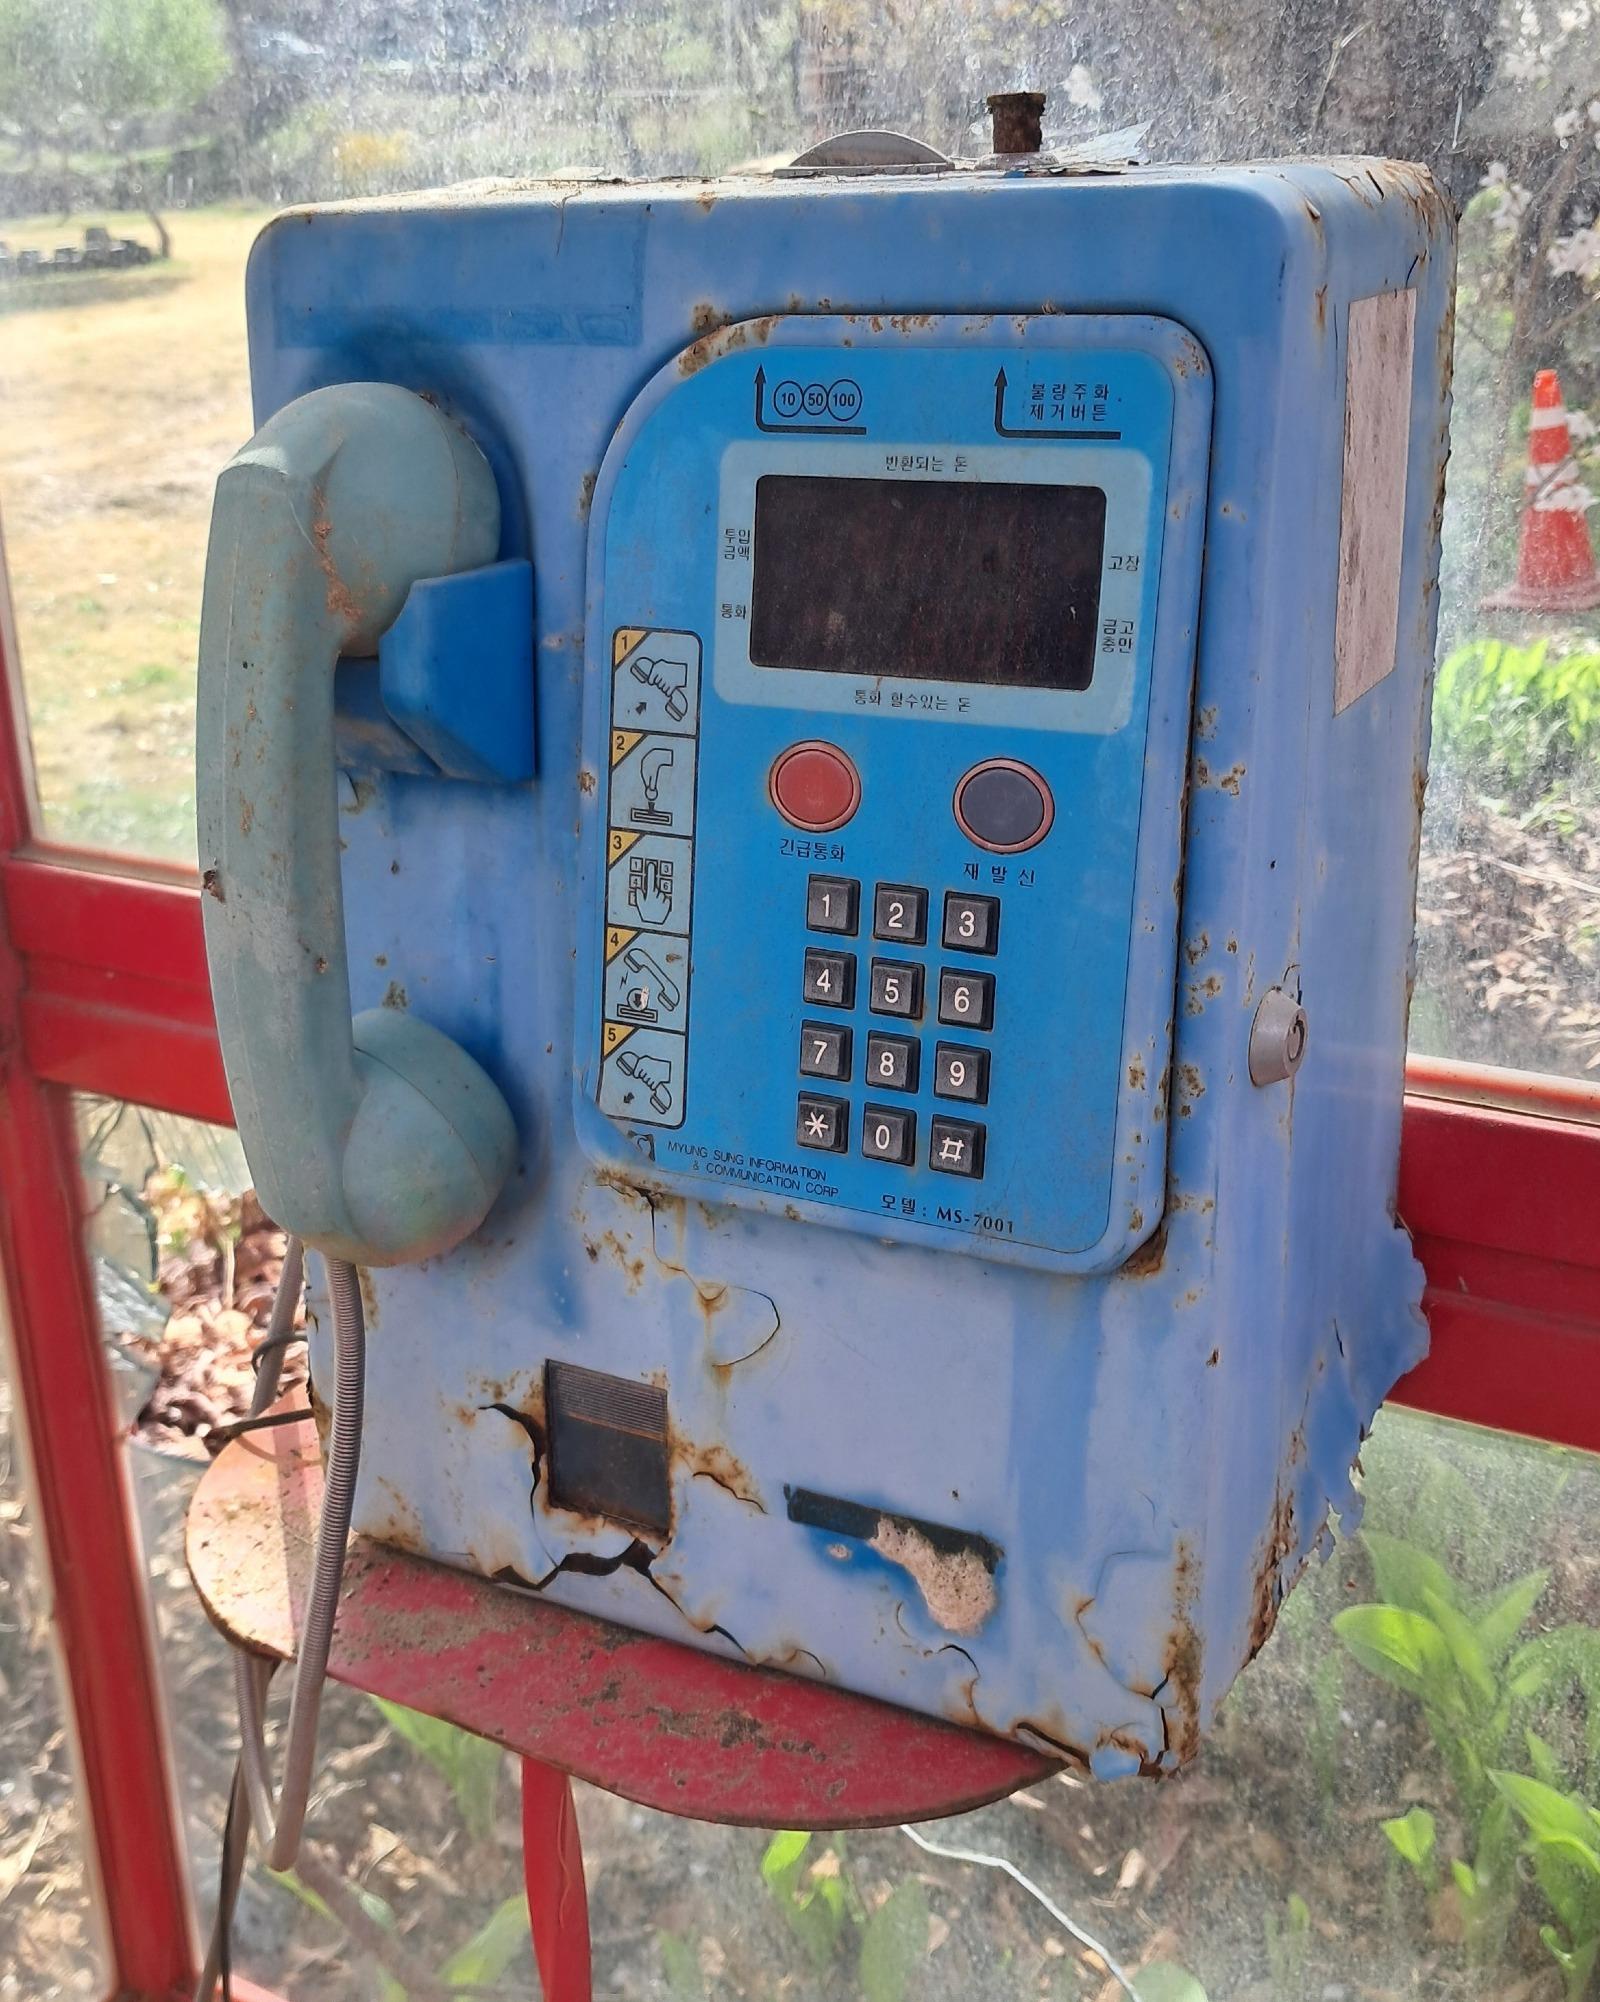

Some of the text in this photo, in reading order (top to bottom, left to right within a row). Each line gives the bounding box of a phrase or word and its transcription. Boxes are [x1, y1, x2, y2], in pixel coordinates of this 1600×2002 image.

[781, 392, 856, 407] 10 50 100
[1031, 383, 1109, 401] 불량주화
[1030, 404, 1107, 422] 제거버튼
[885, 455, 968, 473] 반환되는 돈
[724, 528, 751, 544] 투입
[724, 545, 750, 561] 금액
[1108, 555, 1140, 572] 고장
[721, 603, 747, 620] 통화
[1103, 619, 1134, 635] 금고
[621, 636, 629, 650] 1
[1102, 636, 1132, 654] 충만
[855, 689, 881, 706] 통화
[958, 696, 971, 713] 돈
[616, 735, 625, 751] 2
[613, 835, 622, 851] 3
[779, 838, 845, 863] 긴급통화
[821, 893, 975, 937] 1 2 3
[610, 932, 619, 947] 4
[816, 968, 970, 1012] 4 5 6
[608, 1028, 617, 1042] 5
[813, 1040, 966, 1087] 7 8 9
[875, 1124, 890, 1150] 0
[667, 1140, 827, 1182] MYUNG SUNG INFORMATION
[692, 1160, 839, 1198] & COMMUNICATION CORP
[936, 1206, 1015, 1234] MS-7001
